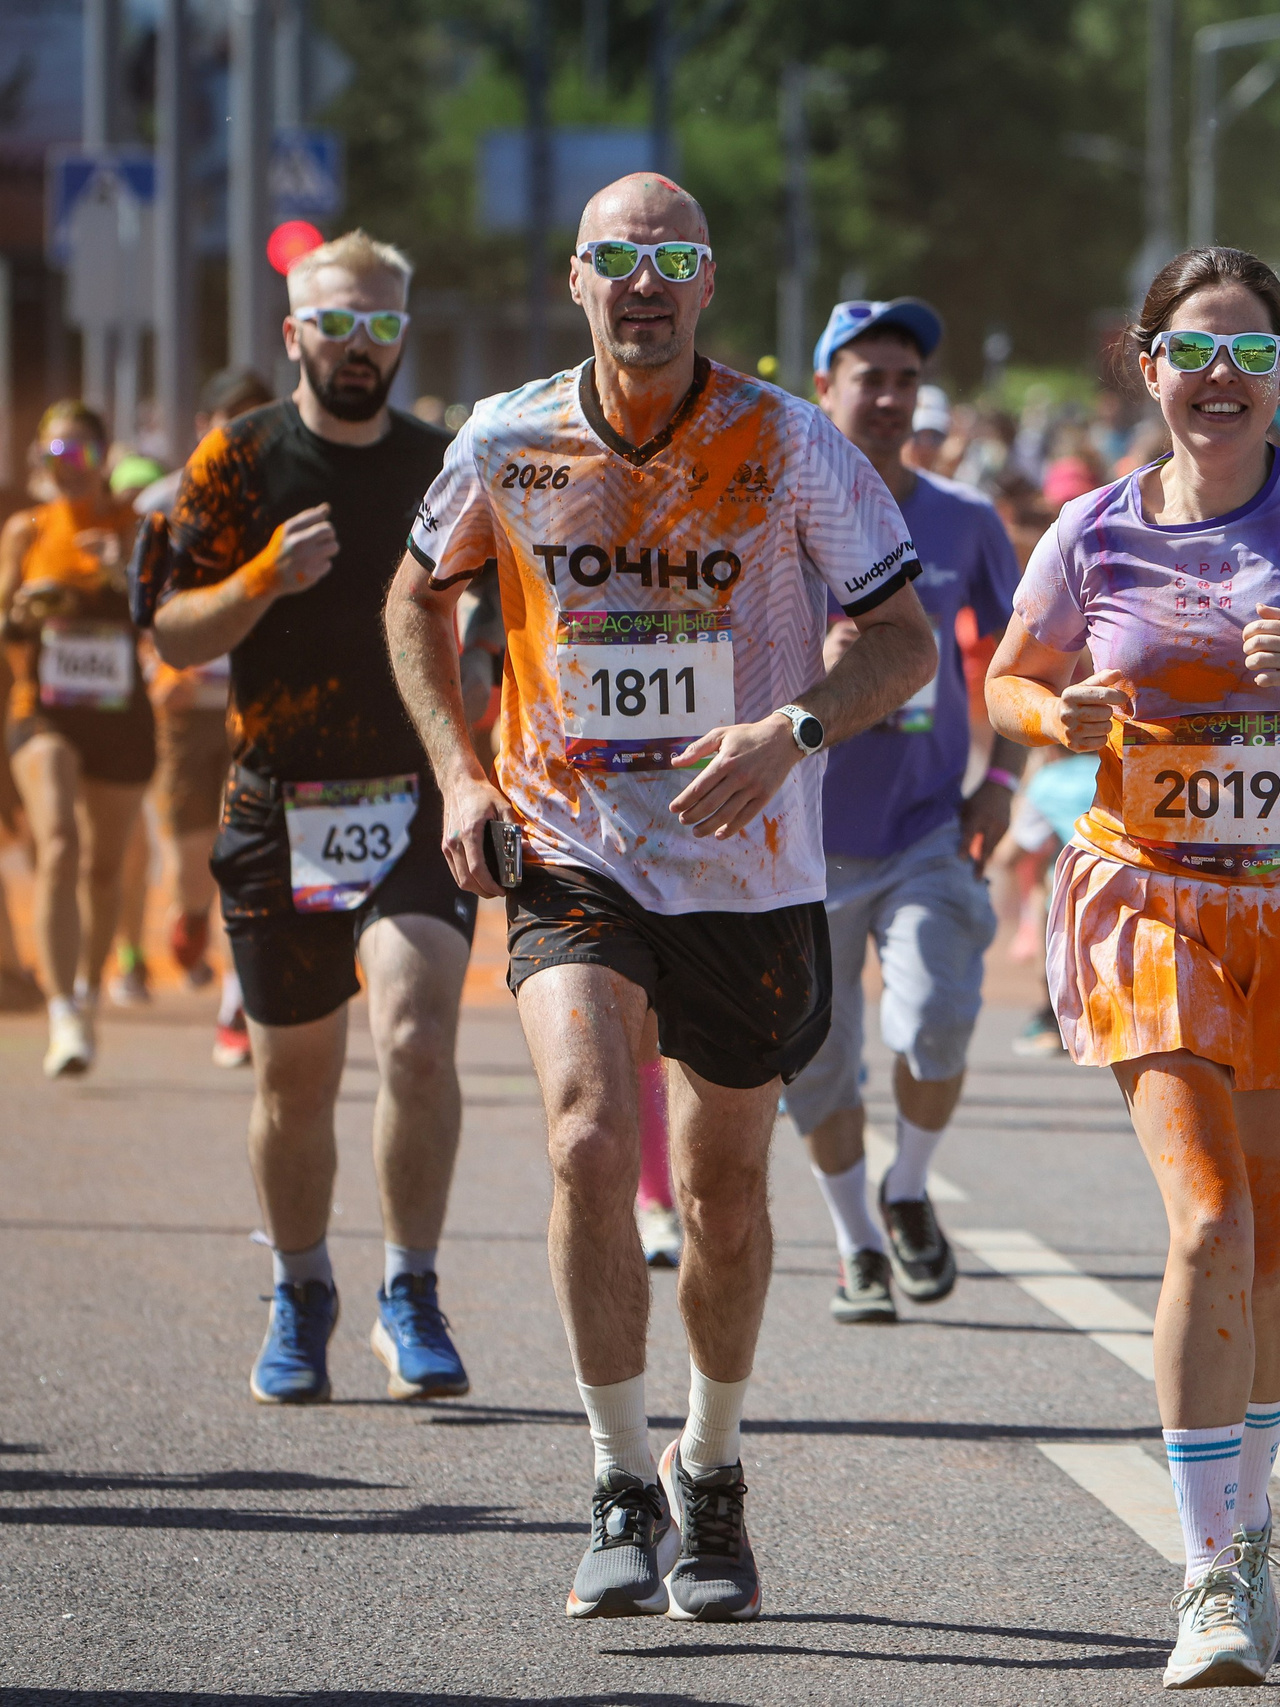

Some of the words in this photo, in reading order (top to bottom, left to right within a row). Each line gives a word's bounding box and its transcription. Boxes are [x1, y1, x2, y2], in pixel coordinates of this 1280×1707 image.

[502, 463, 571, 489] 2026
[532, 544, 742, 591] ТОЧНО
[1175, 561, 1233, 576] КРА
[656, 631, 729, 645] 2026
[592, 666, 696, 717] 1811
[322, 823, 392, 864] 433
